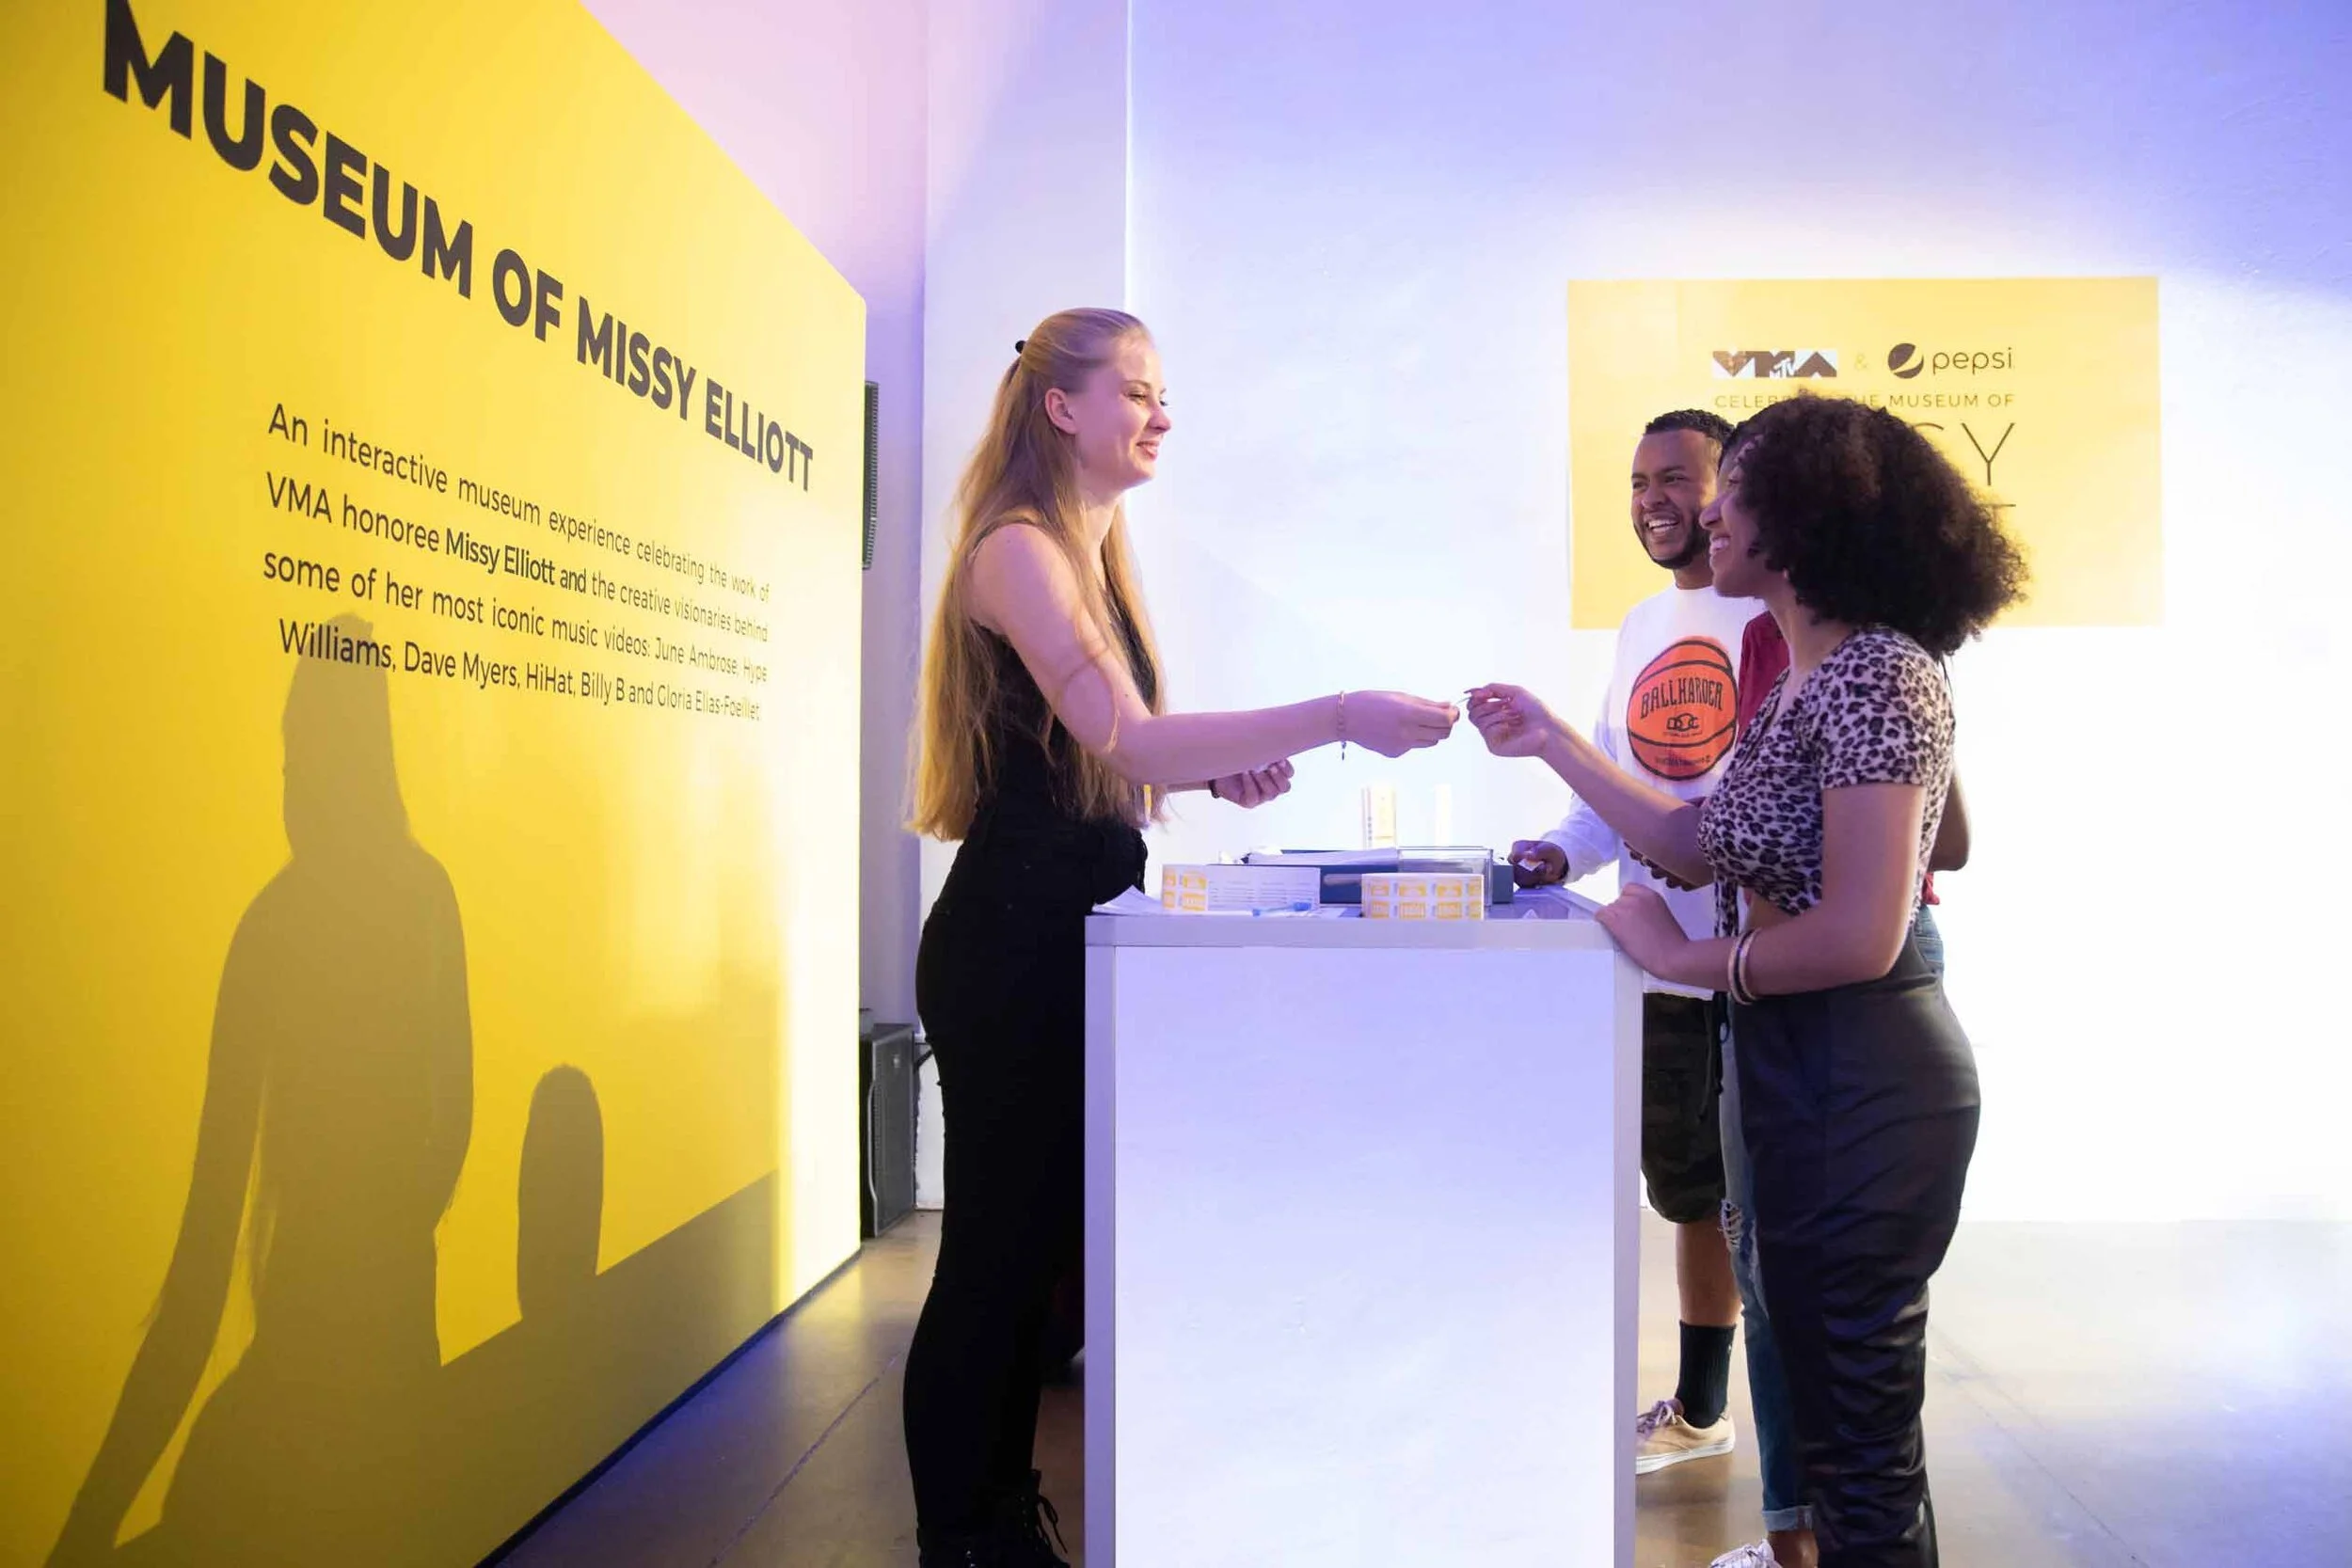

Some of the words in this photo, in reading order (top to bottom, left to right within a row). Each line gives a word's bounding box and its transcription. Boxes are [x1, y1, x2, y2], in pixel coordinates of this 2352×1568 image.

[104, 0, 472, 299] MUSEUM
[492, 248, 564, 342] OF
[577, 295, 696, 420] MISSY
[705, 377, 814, 492] ELLIOTT
[1888, 393, 1979, 408] MUSEUM
[1987, 393, 2015, 408] OF
[1931, 346, 2014, 375] pepsi
[266, 470, 332, 523] VMA
[342, 493, 439, 552] honoree
[446, 527, 500, 574] Missy
[504, 544, 555, 586] Elliott
[560, 568, 587, 594] and
[592, 570, 615, 601] the
[620, 584, 671, 615] creative
[675, 595, 731, 632] visionaries
[734, 611, 768, 642] behind
[268, 403, 308, 447] An
[323, 418, 448, 493] interactive
[458, 476, 541, 526] museum
[548, 510, 630, 556] experience
[636, 540, 705, 585] celebrating
[709, 564, 727, 588] the
[731, 574, 756, 598] work
[759, 583, 771, 603] of
[263, 551, 341, 593] some
[351, 567, 377, 600] of
[386, 571, 423, 610] her
[433, 591, 484, 625] most
[492, 597, 545, 636] iconic
[551, 617, 598, 647] music
[604, 625, 650, 657] videos:
[655, 637, 685, 665] June
[743, 657, 768, 684] Hype
[278, 617, 396, 673] Williams,
[405, 641, 456, 678] Dave
[463, 651, 521, 690] Myers,
[526, 662, 576, 698] HiHat,
[581, 672, 612, 705] Billy
[616, 677, 625, 702] B
[628, 682, 654, 705] and
[658, 684, 692, 710] Gloria
